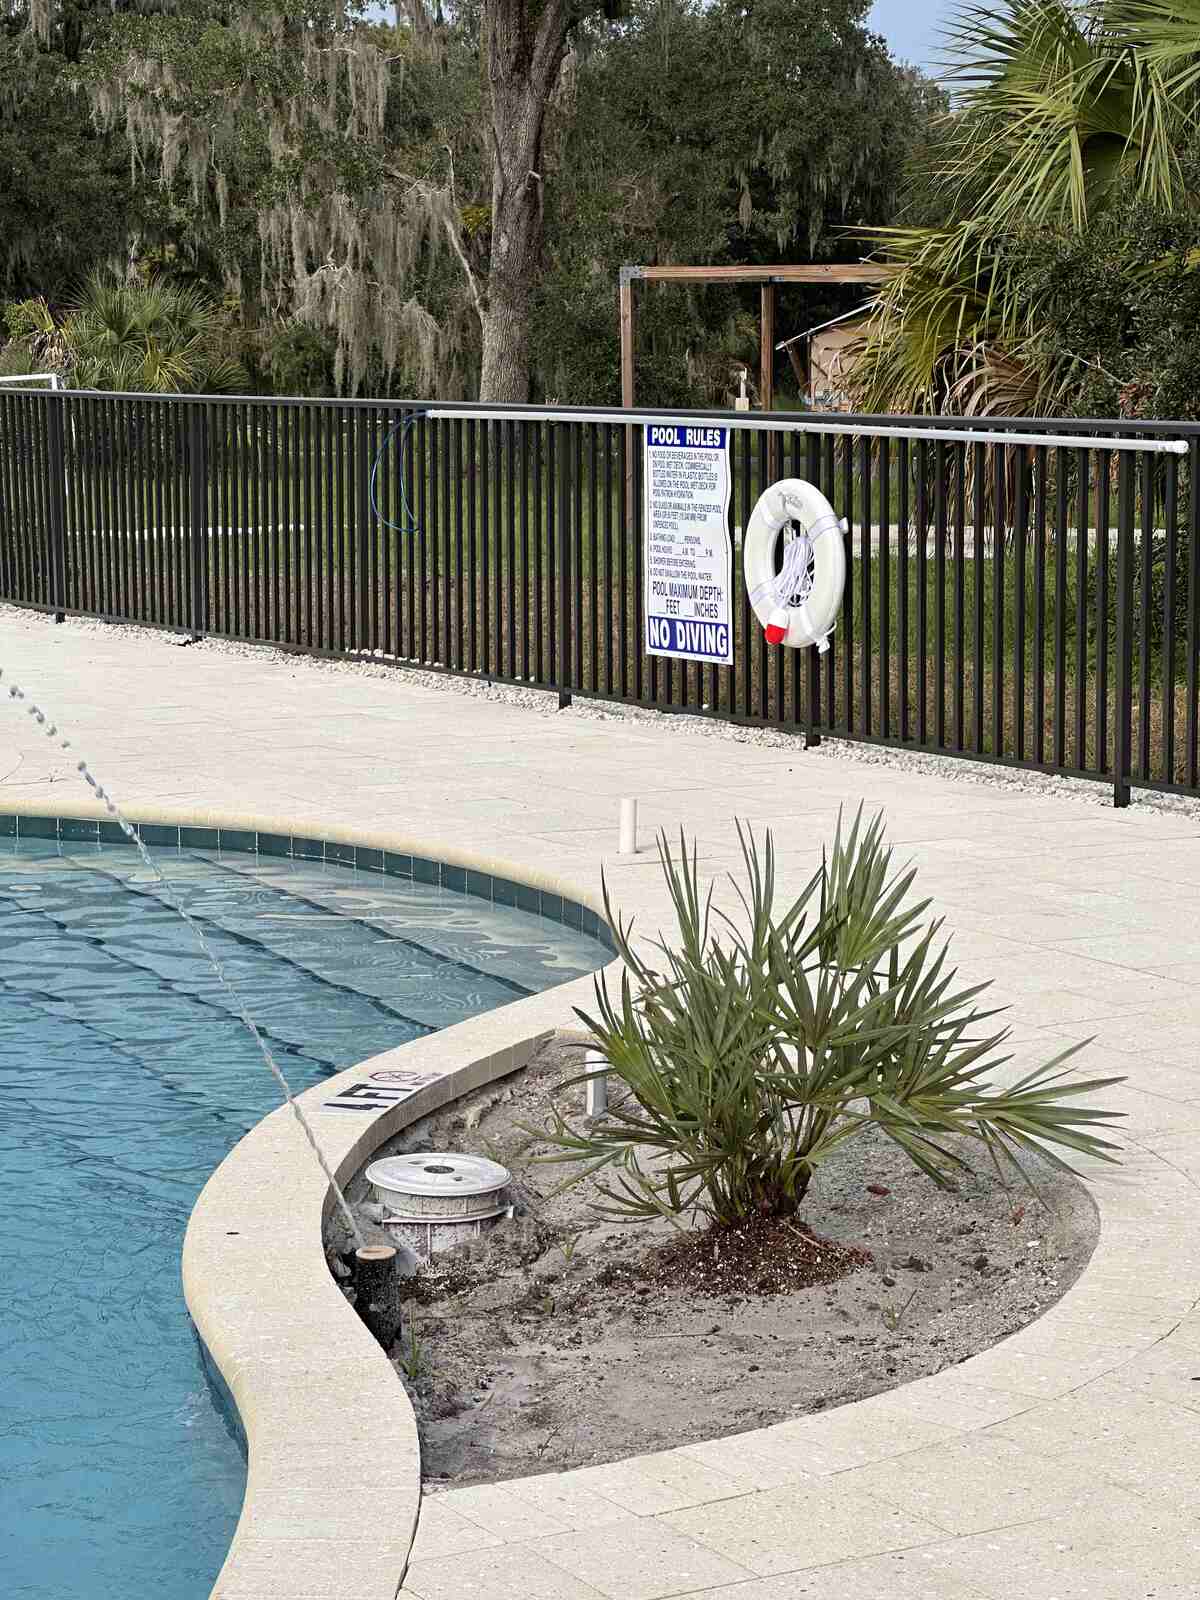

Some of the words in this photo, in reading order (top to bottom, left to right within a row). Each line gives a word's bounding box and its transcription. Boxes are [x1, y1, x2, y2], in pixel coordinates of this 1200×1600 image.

[651, 427, 681, 445] POOL
[686, 429, 721, 447] RULES
[652, 580, 668, 596] POOL
[669, 582, 698, 599] MAXIMUM
[700, 585, 724, 602] DEPTH:
[694, 602, 719, 619] INCHES
[649, 617, 670, 648] NO
[676, 621, 728, 656] DIVING
